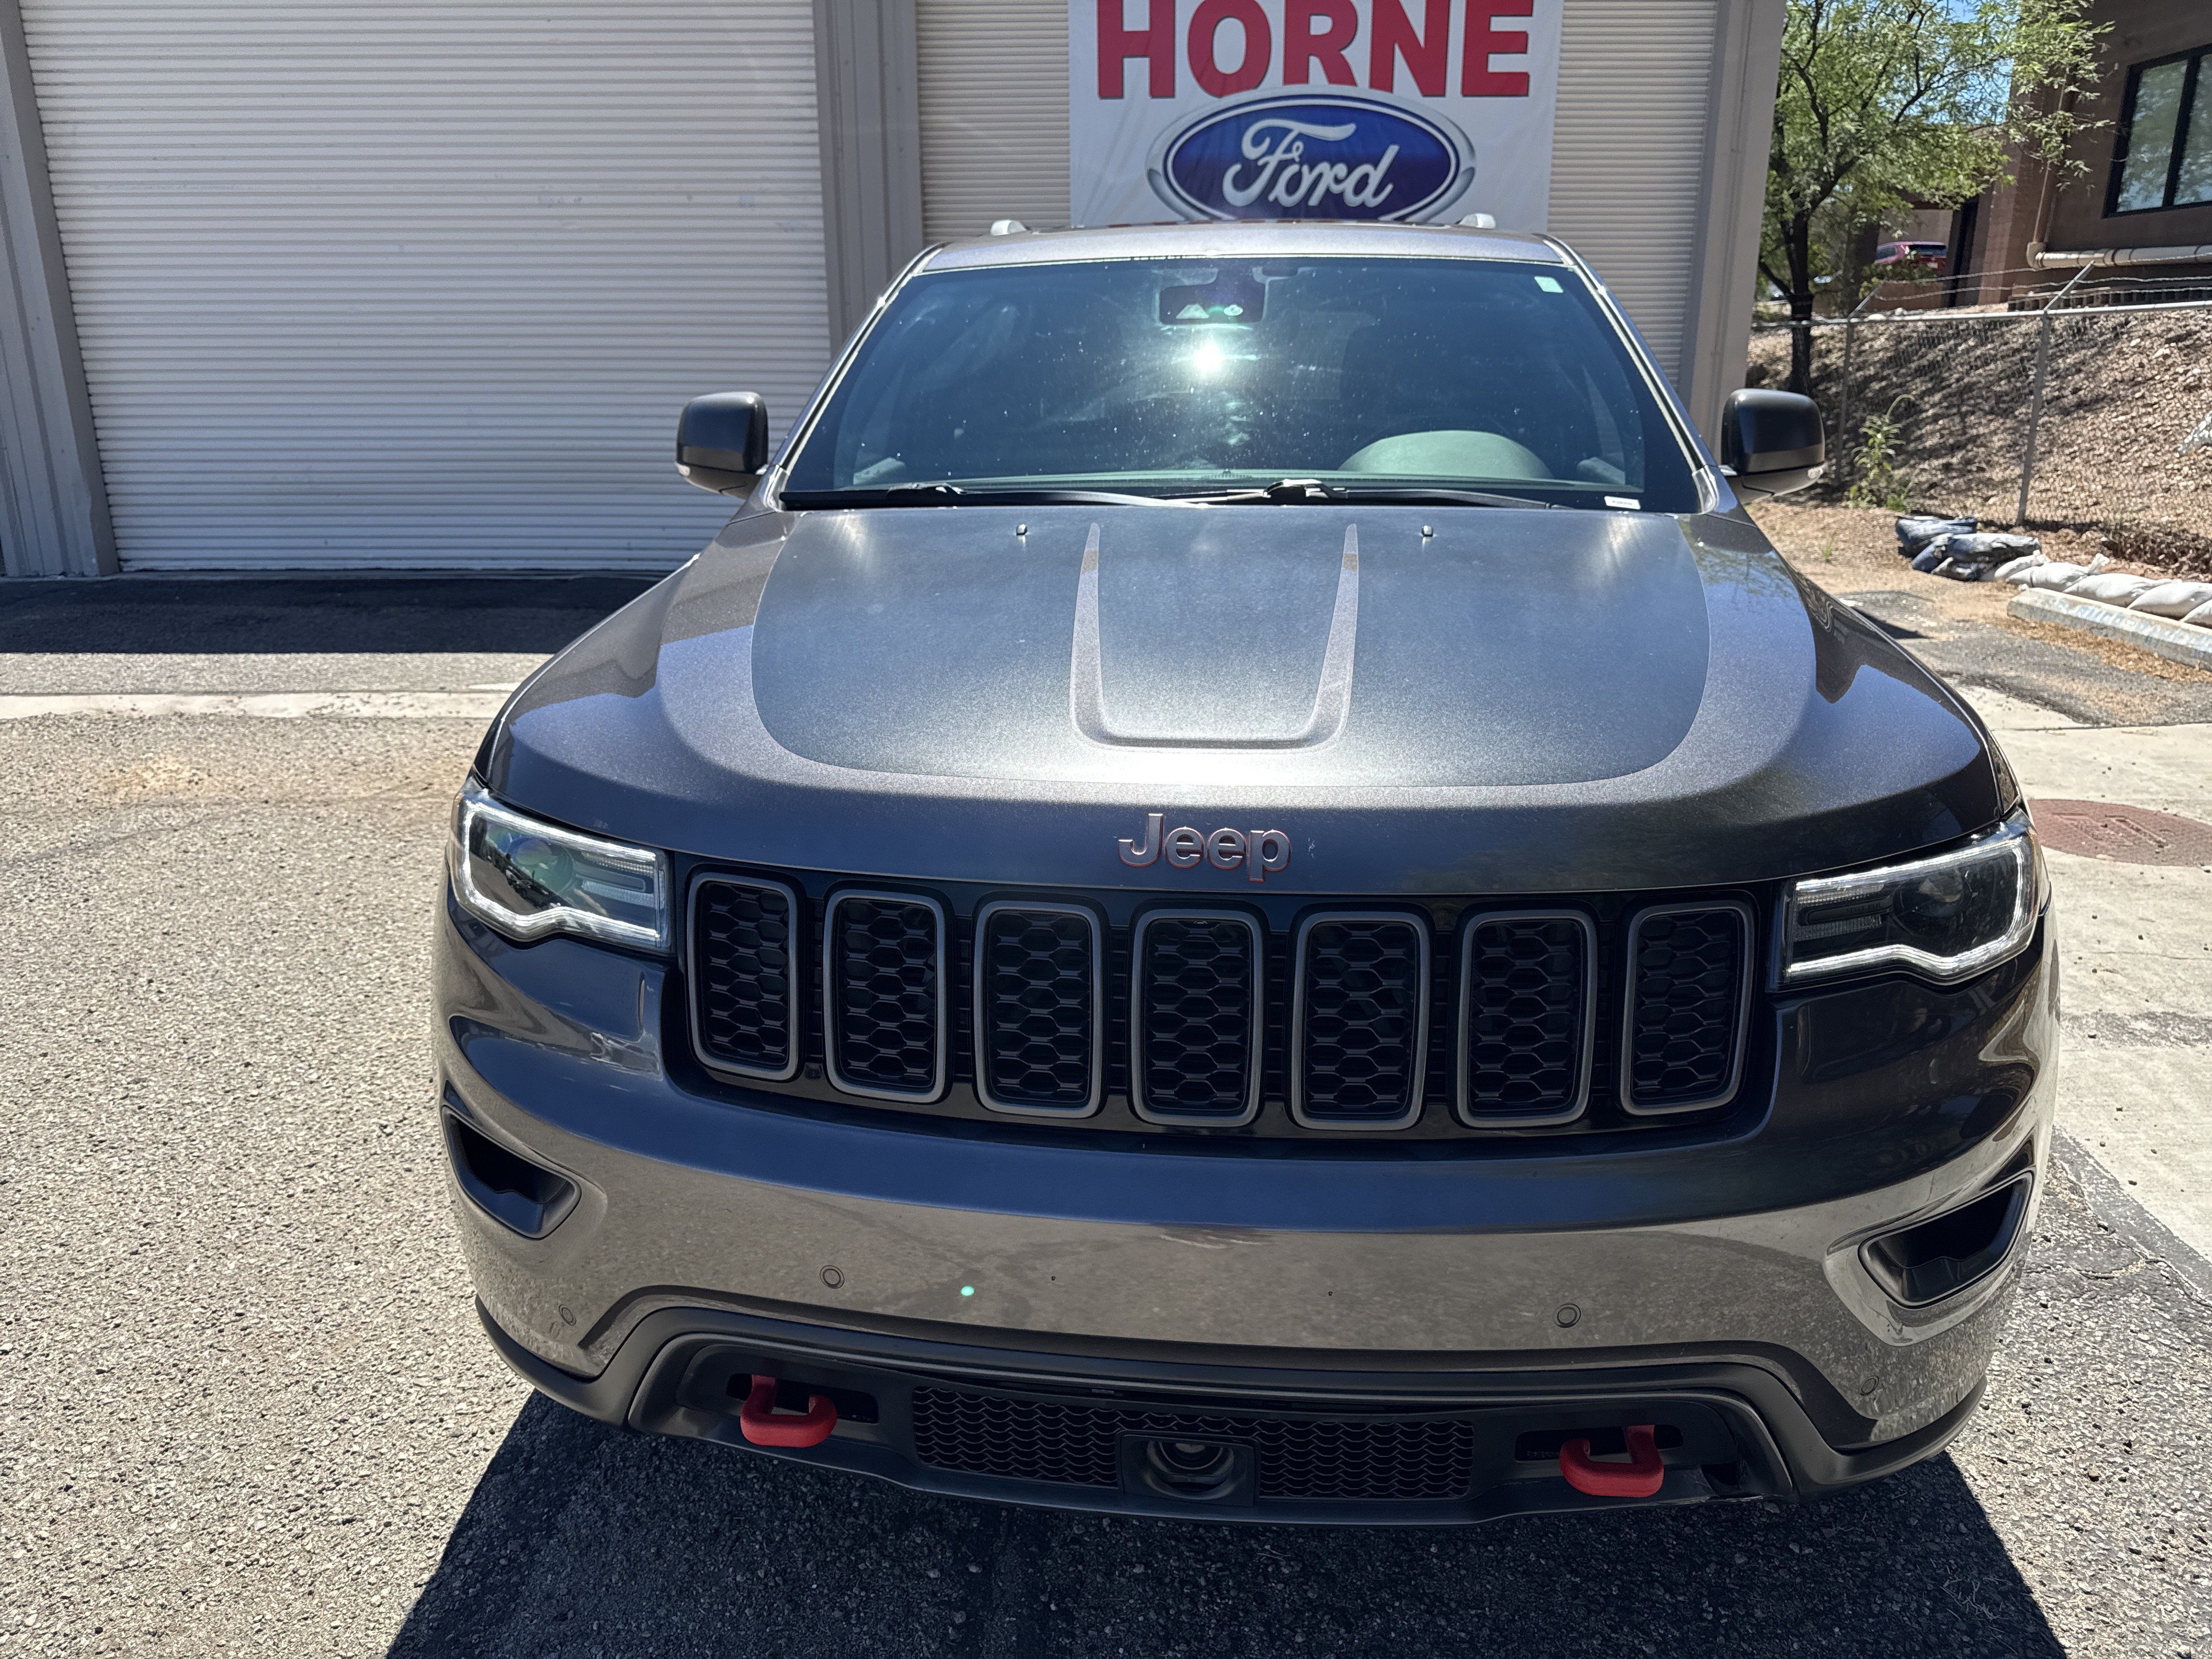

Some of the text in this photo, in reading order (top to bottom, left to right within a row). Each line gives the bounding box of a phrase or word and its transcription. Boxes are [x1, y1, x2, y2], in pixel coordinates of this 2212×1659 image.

[1097, 0, 1533, 99] HORNE
[1222, 118, 1400, 208] Ford
[1117, 812, 1291, 883] Jeep
